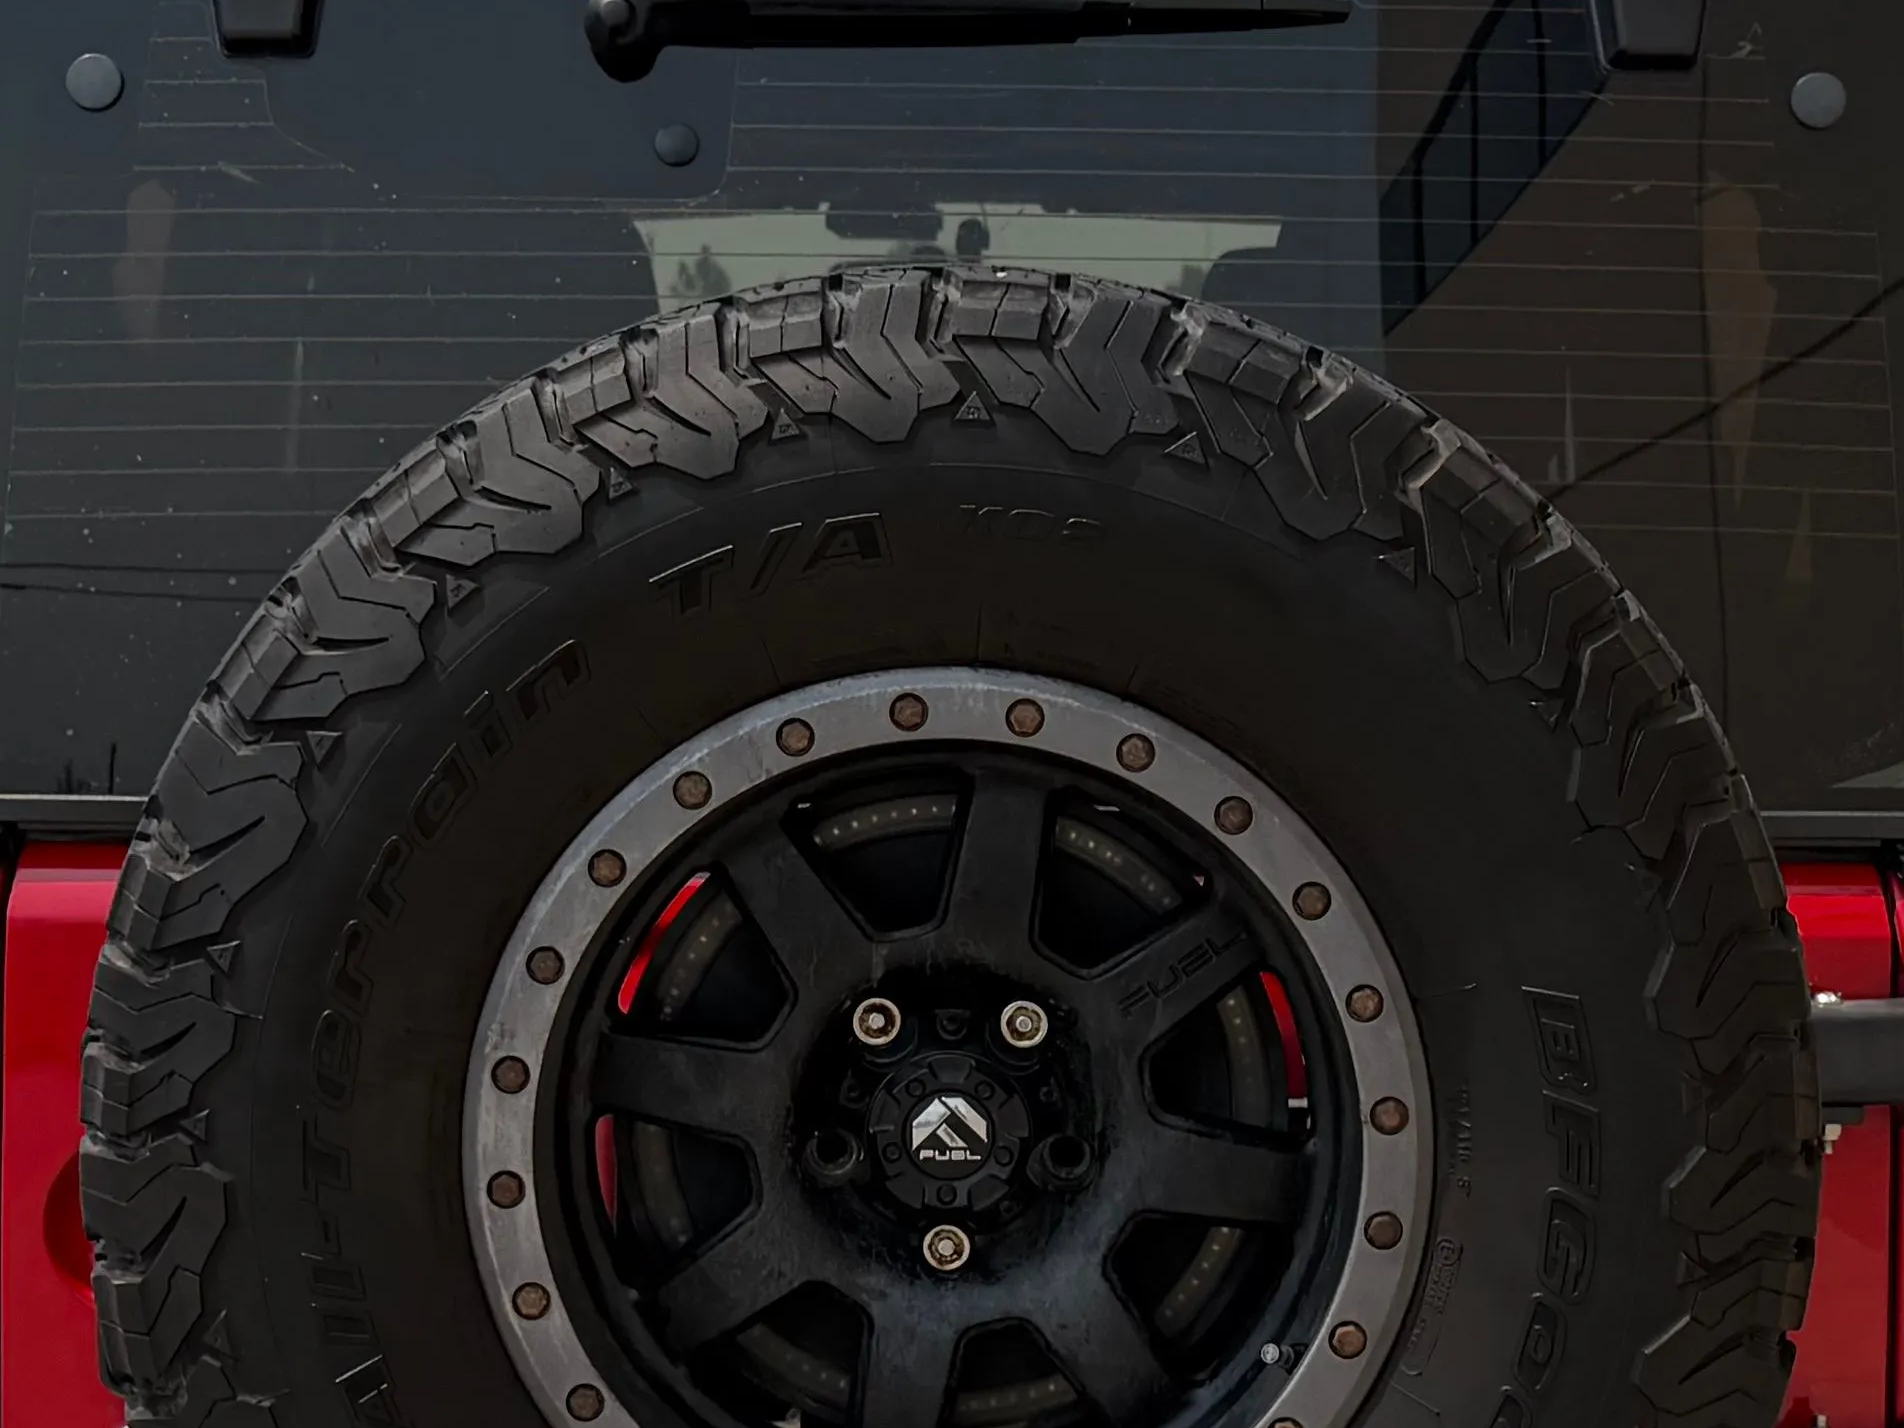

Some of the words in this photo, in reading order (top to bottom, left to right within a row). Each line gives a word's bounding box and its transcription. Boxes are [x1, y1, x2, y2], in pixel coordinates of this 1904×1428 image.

[648, 510, 893, 624] T/A
[1116, 932, 1247, 1021] FUEL
[919, 1149, 981, 1161] FUEL
